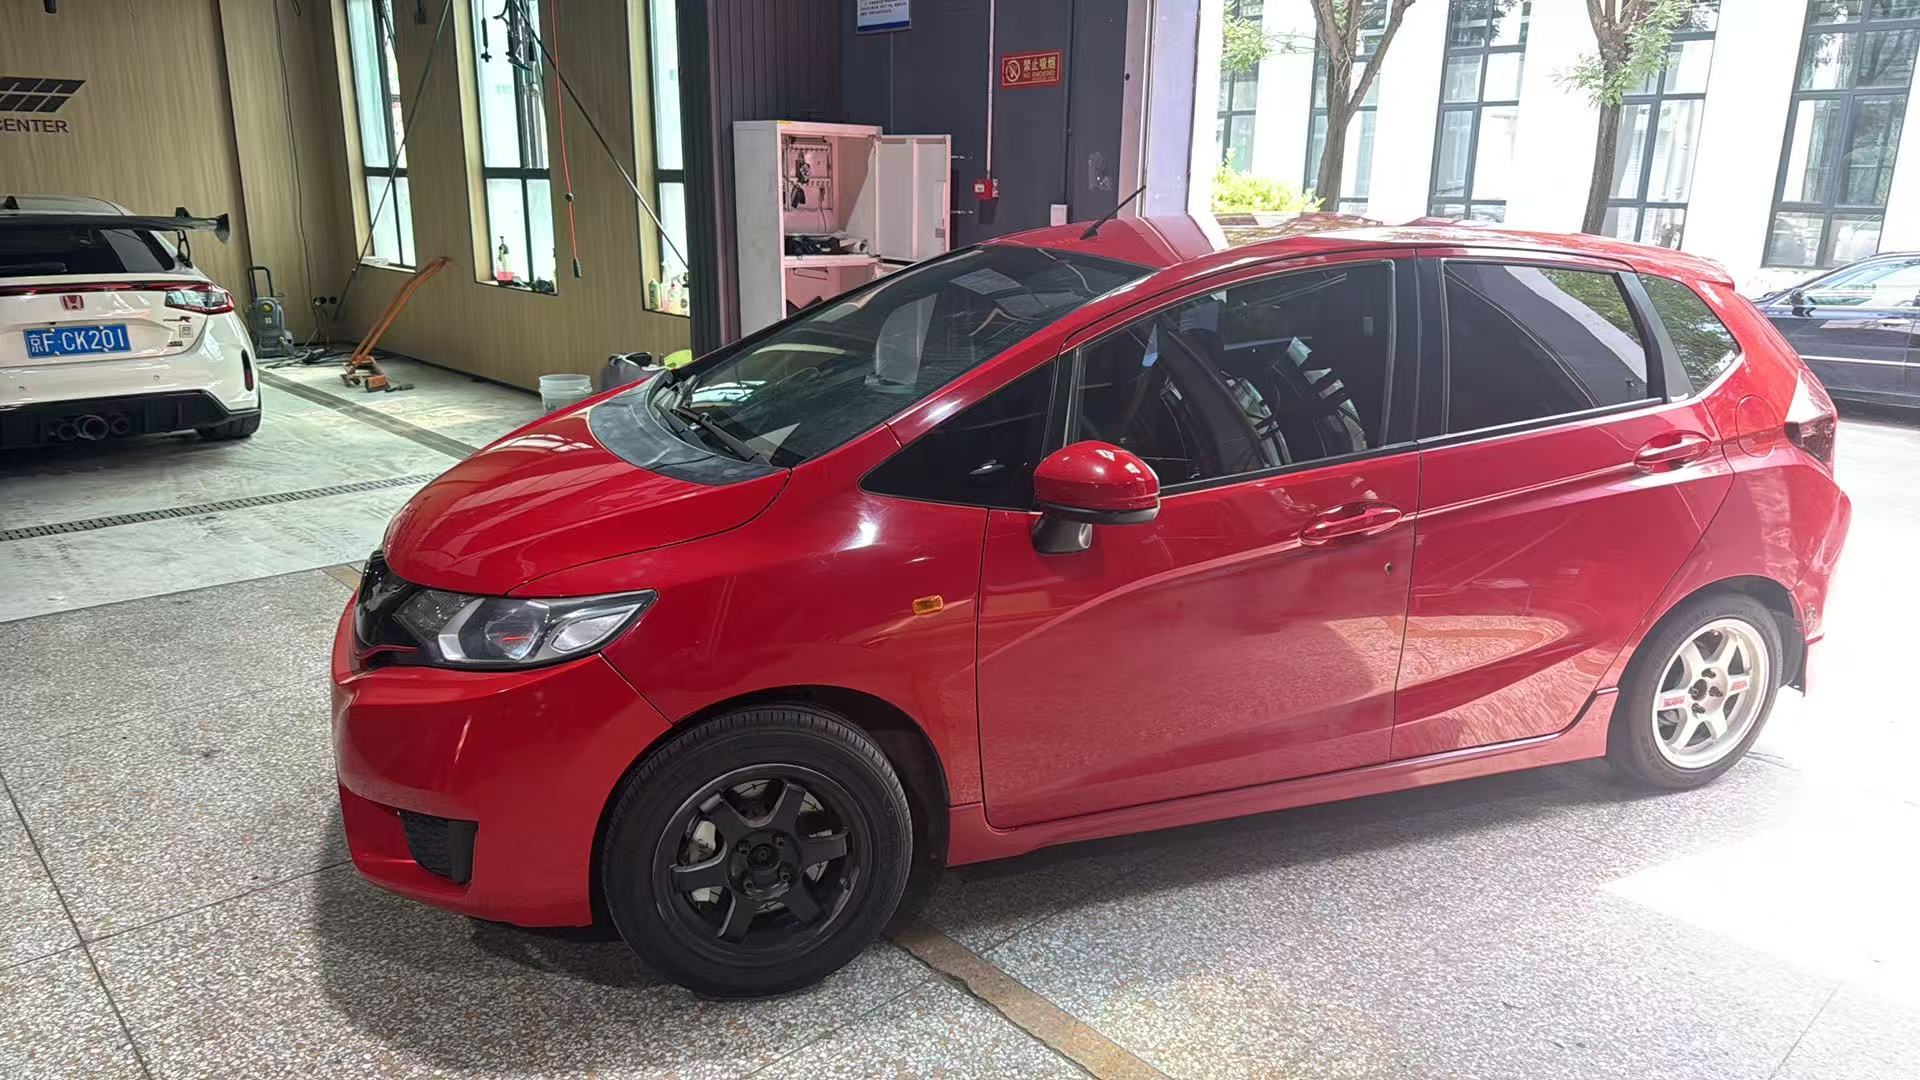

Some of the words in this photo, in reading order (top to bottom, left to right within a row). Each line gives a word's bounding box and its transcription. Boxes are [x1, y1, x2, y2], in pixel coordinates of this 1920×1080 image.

[1023, 56, 1056, 71] 禁止吸烟
[0, 118, 69, 133] ENTER
